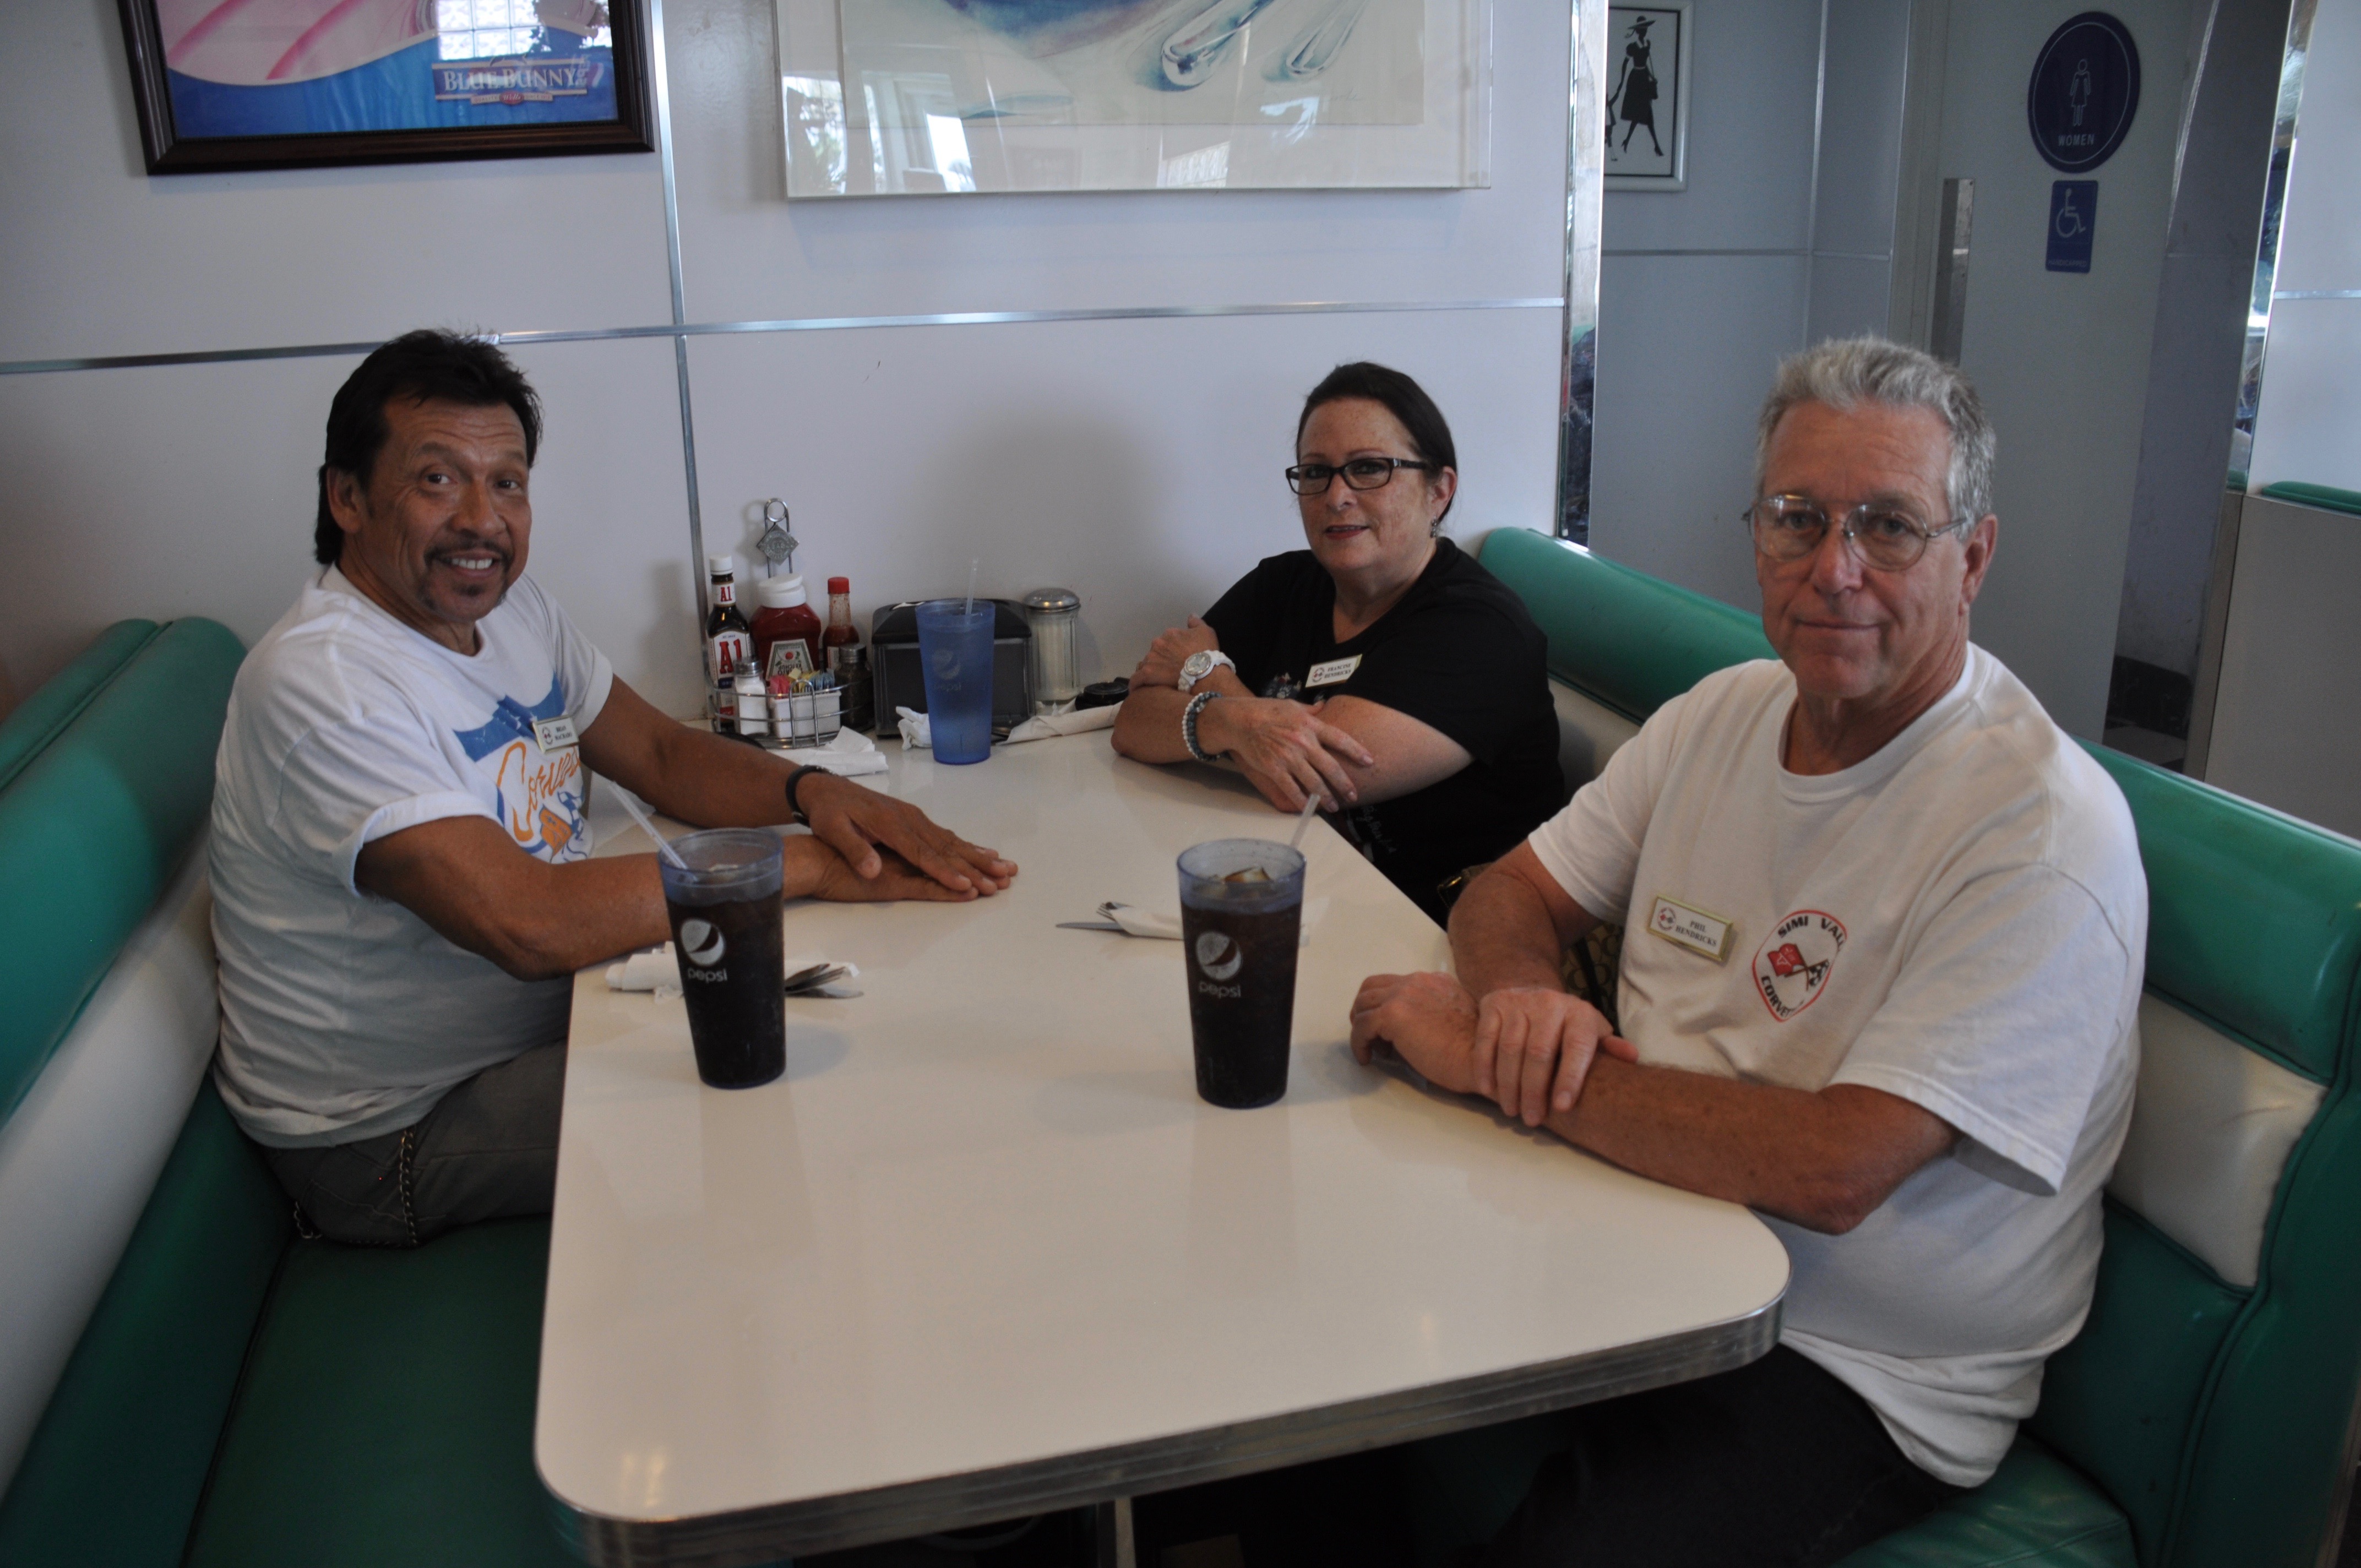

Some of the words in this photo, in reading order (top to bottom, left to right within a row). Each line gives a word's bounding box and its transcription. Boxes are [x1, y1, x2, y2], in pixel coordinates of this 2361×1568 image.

[444, 70, 501, 91] BLUE
[502, 67, 576, 89] BUNNY
[2058, 134, 2096, 147] WOMEN
[2048, 259, 2087, 268] HANDICAPPED
[1690, 919, 1706, 932] PHIL
[1777, 916, 1809, 939] SIMI
[1675, 924, 1717, 947] HENDRICKS
[687, 967, 727, 983] pepsi
[1198, 981, 1242, 999] pepsi
